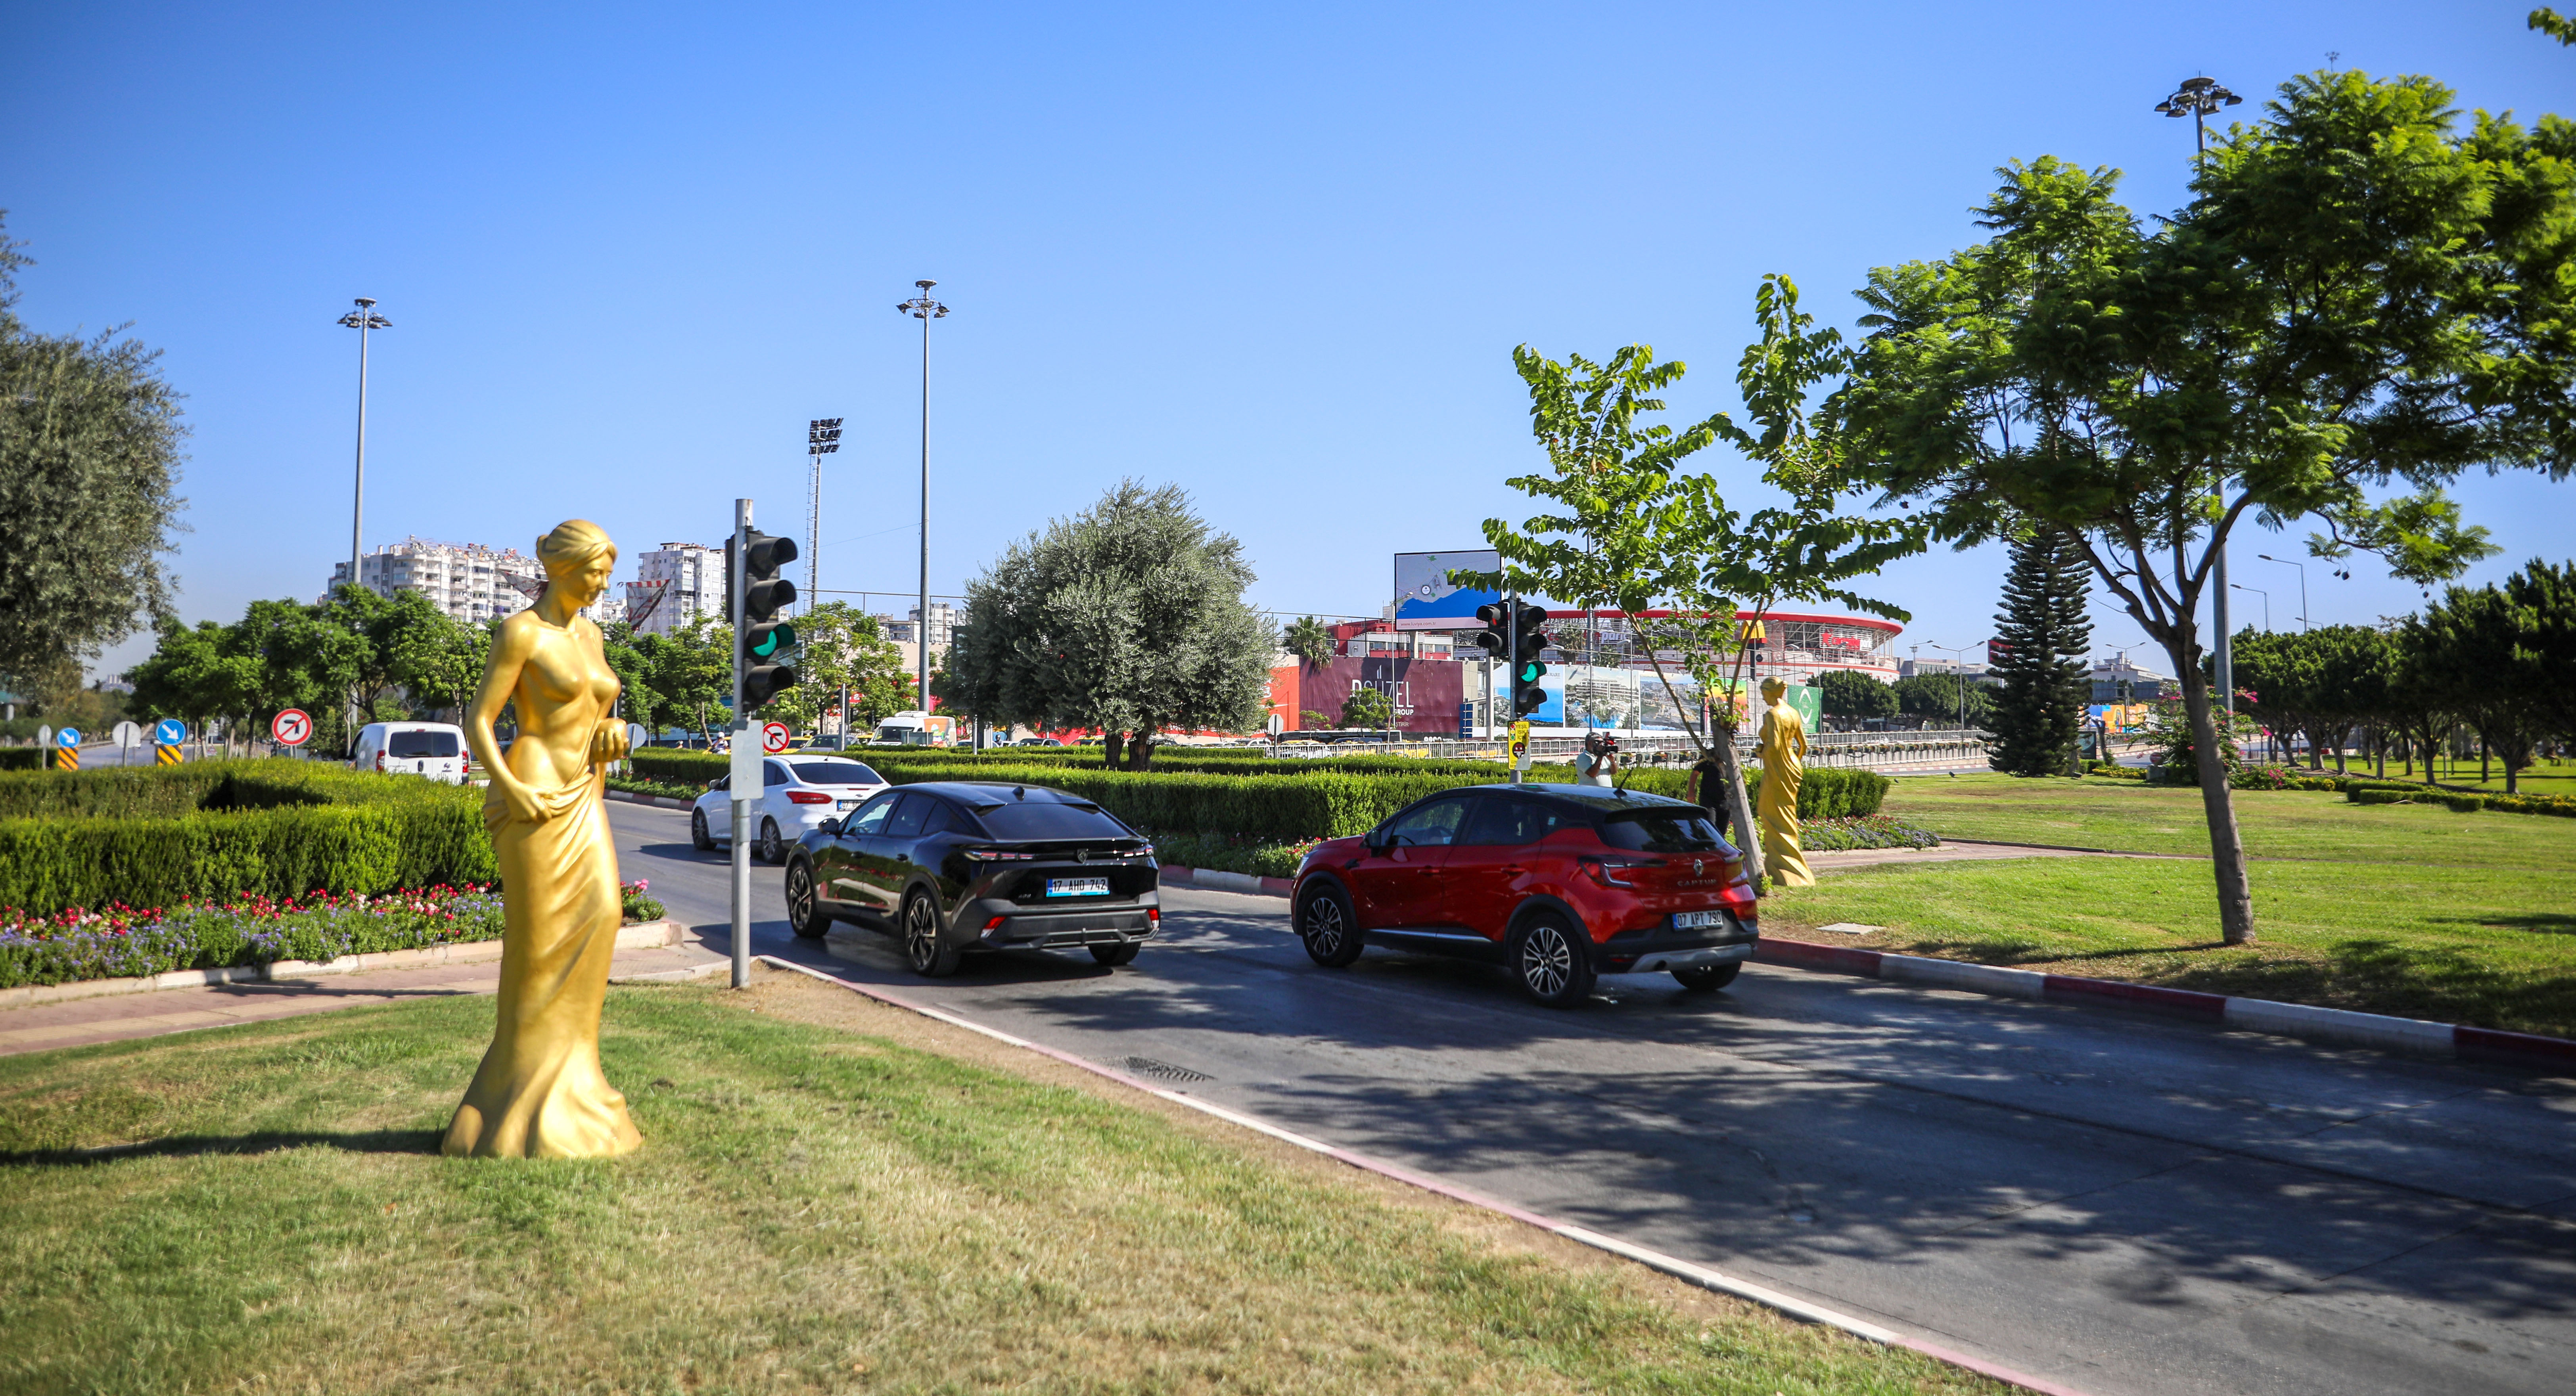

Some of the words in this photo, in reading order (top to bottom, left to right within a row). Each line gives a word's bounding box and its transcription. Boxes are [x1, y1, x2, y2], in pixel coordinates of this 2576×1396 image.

[1053, 880, 1062, 892] 17
[1069, 880, 1085, 891] AHD
[1091, 879, 1106, 891] 742
[1678, 914, 1686, 926] 07
[1690, 912, 1704, 925] APT
[1708, 911, 1721, 924] 790
